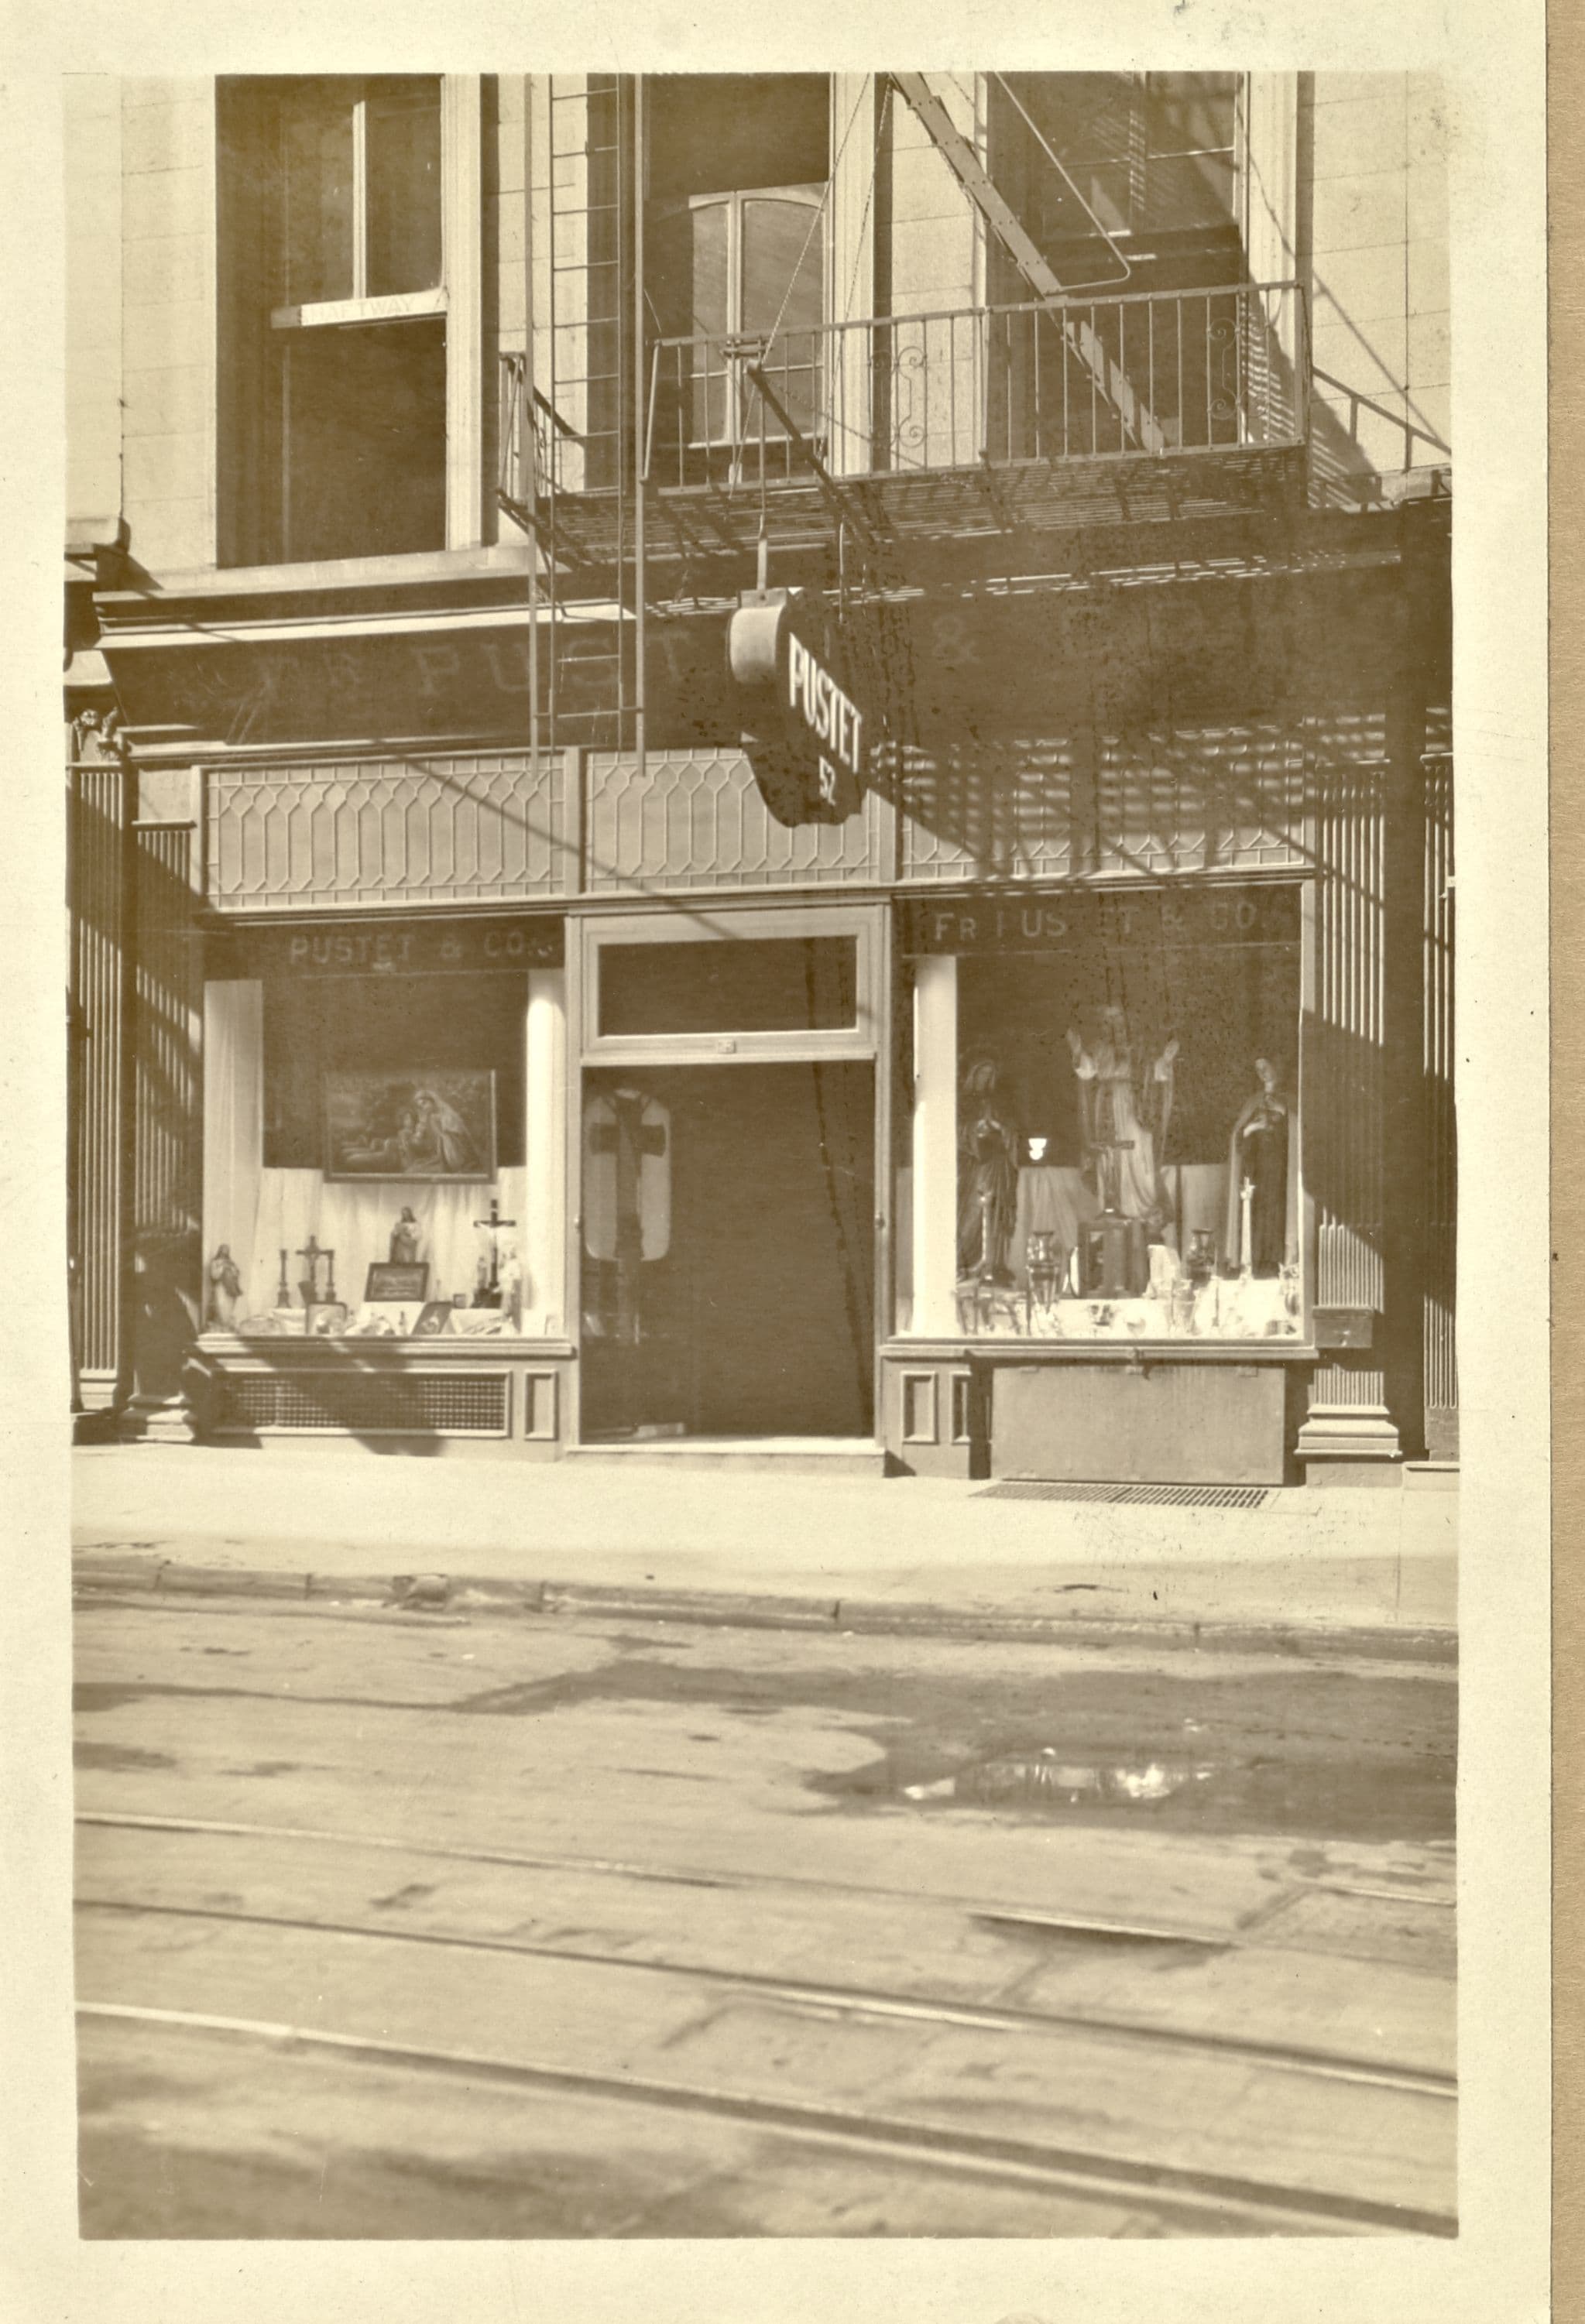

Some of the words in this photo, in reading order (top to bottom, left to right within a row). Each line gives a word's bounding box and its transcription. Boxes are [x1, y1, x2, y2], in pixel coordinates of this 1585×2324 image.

[789, 632, 862, 773] PUSTET
[819, 754, 835, 806] 52
[289, 934, 415, 965] PUSTET
[441, 934, 461, 959] &
